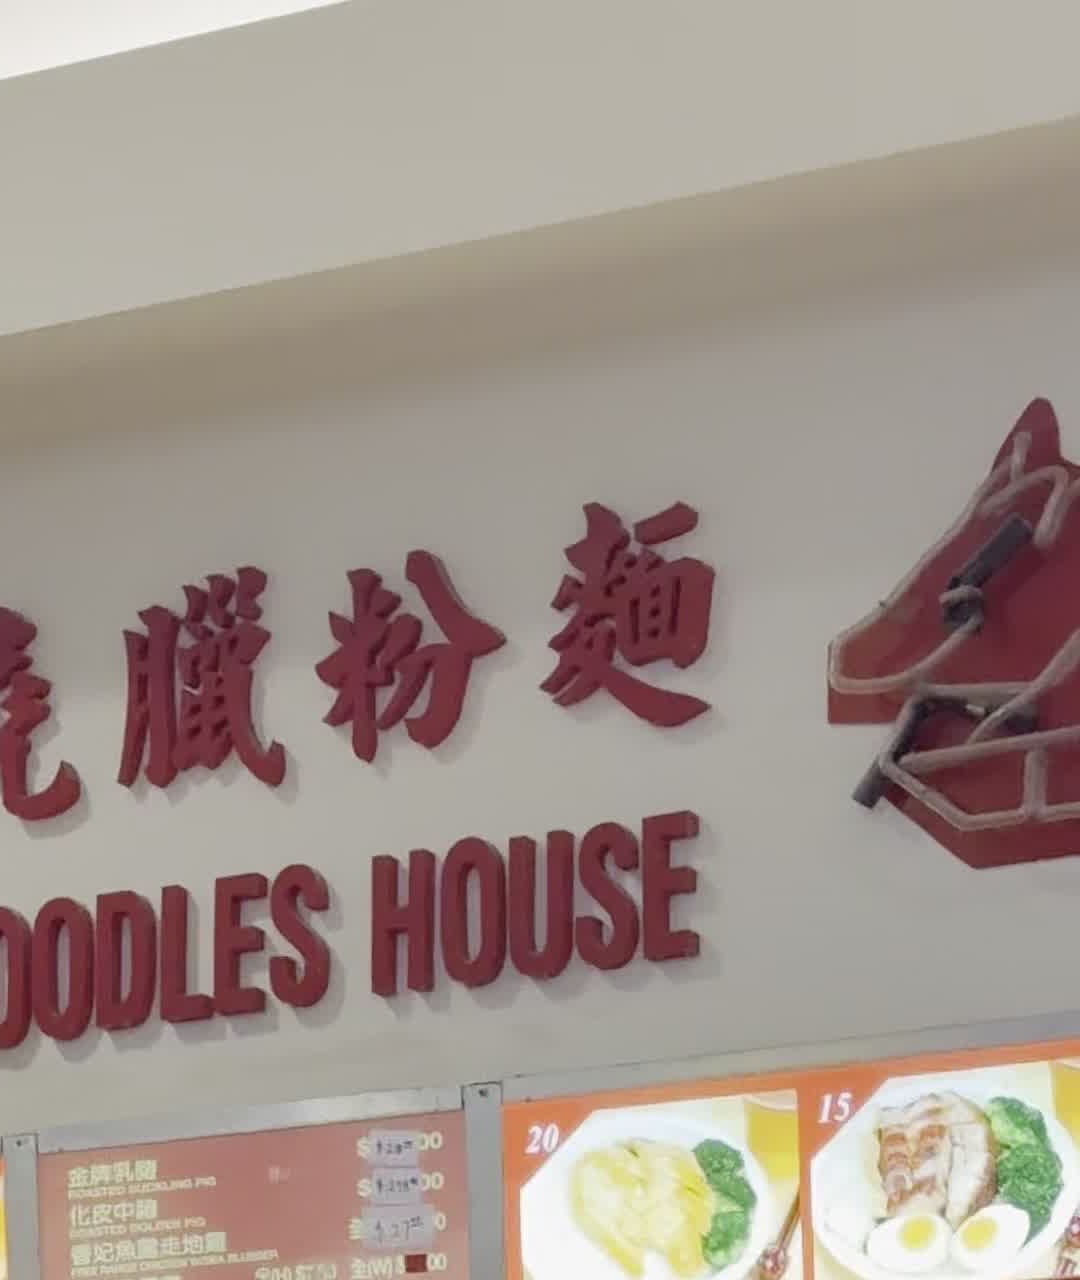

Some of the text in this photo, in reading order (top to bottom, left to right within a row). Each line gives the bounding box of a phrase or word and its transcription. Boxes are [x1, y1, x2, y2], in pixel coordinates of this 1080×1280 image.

[371, 811, 701, 997] HOUSE
[818, 1092, 852, 1124] 15
[525, 1124, 560, 1154] 20
